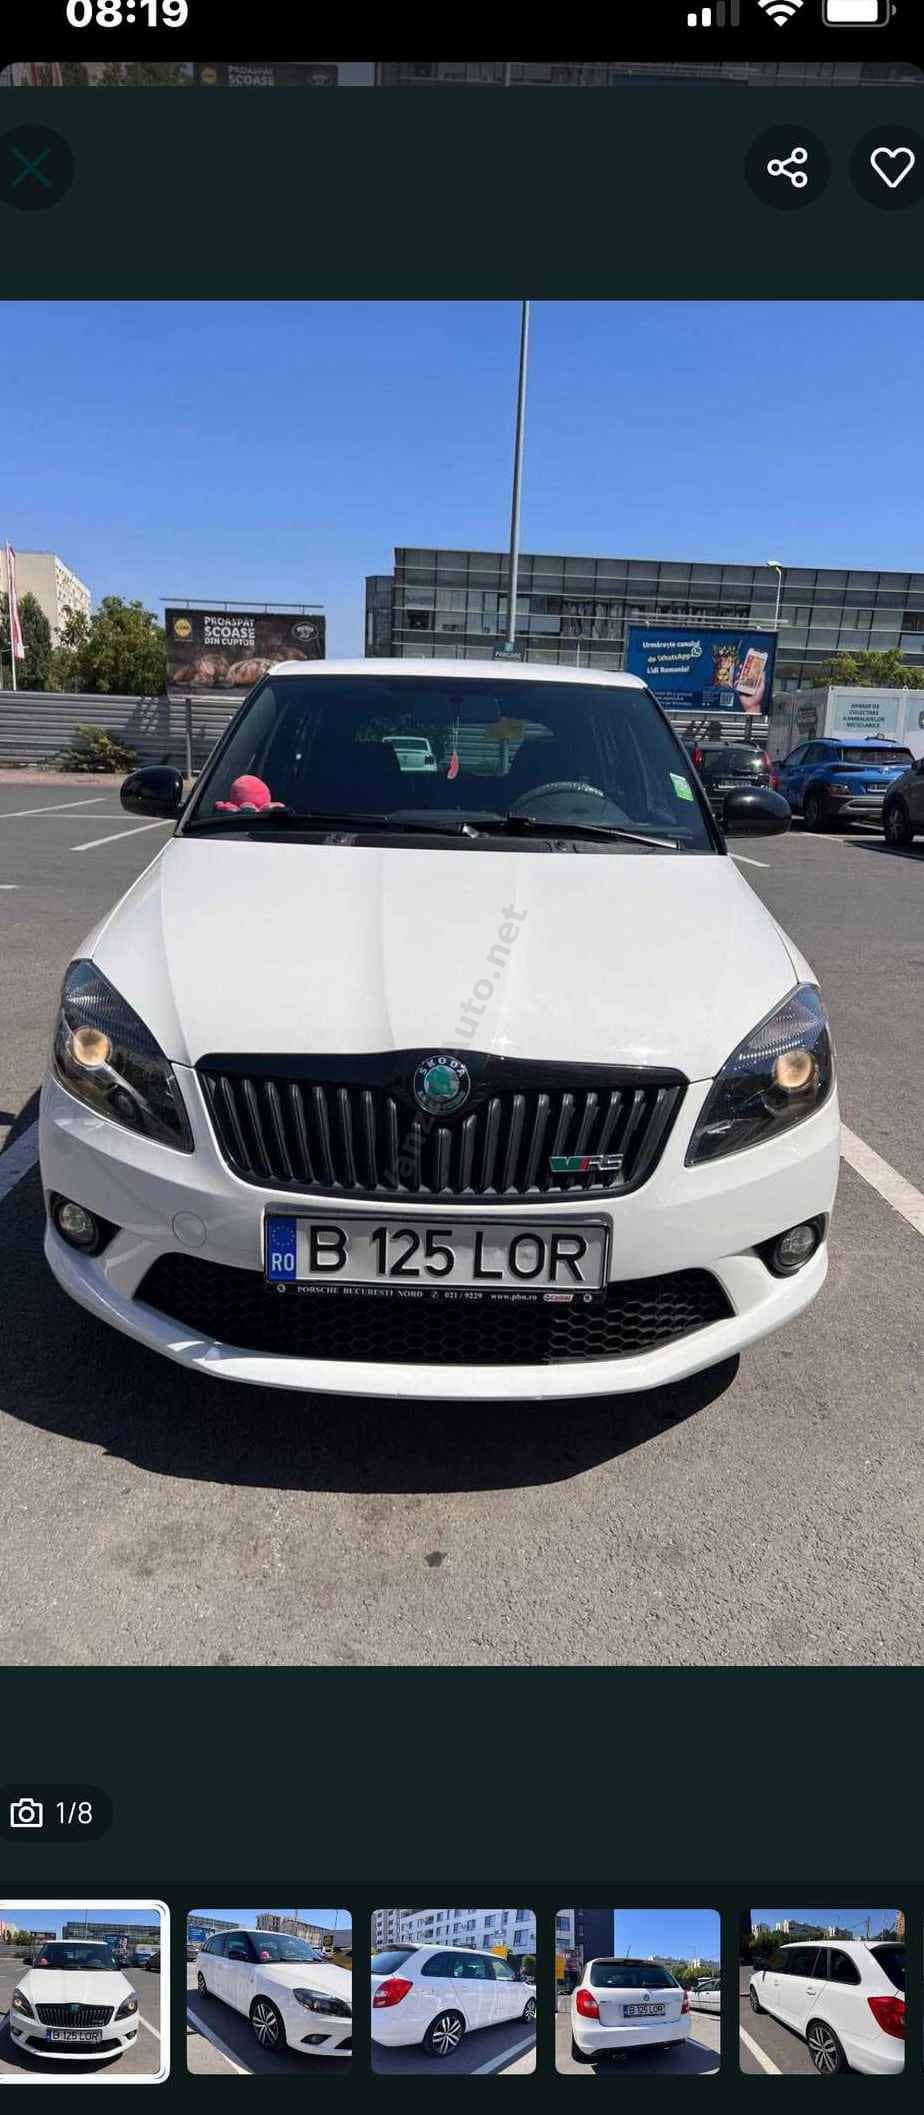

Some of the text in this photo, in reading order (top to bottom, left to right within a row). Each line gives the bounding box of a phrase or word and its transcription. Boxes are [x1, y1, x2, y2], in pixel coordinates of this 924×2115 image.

[204, 626, 256, 639] SCOASE
[204, 637, 255, 646] DIN CUPTOR
[309, 1225, 591, 1282] B 125 LOR
[271, 1252, 295, 1273] RO
[297, 1286, 339, 1294] PORSCHE
[397, 1289, 424, 1297] NORD
